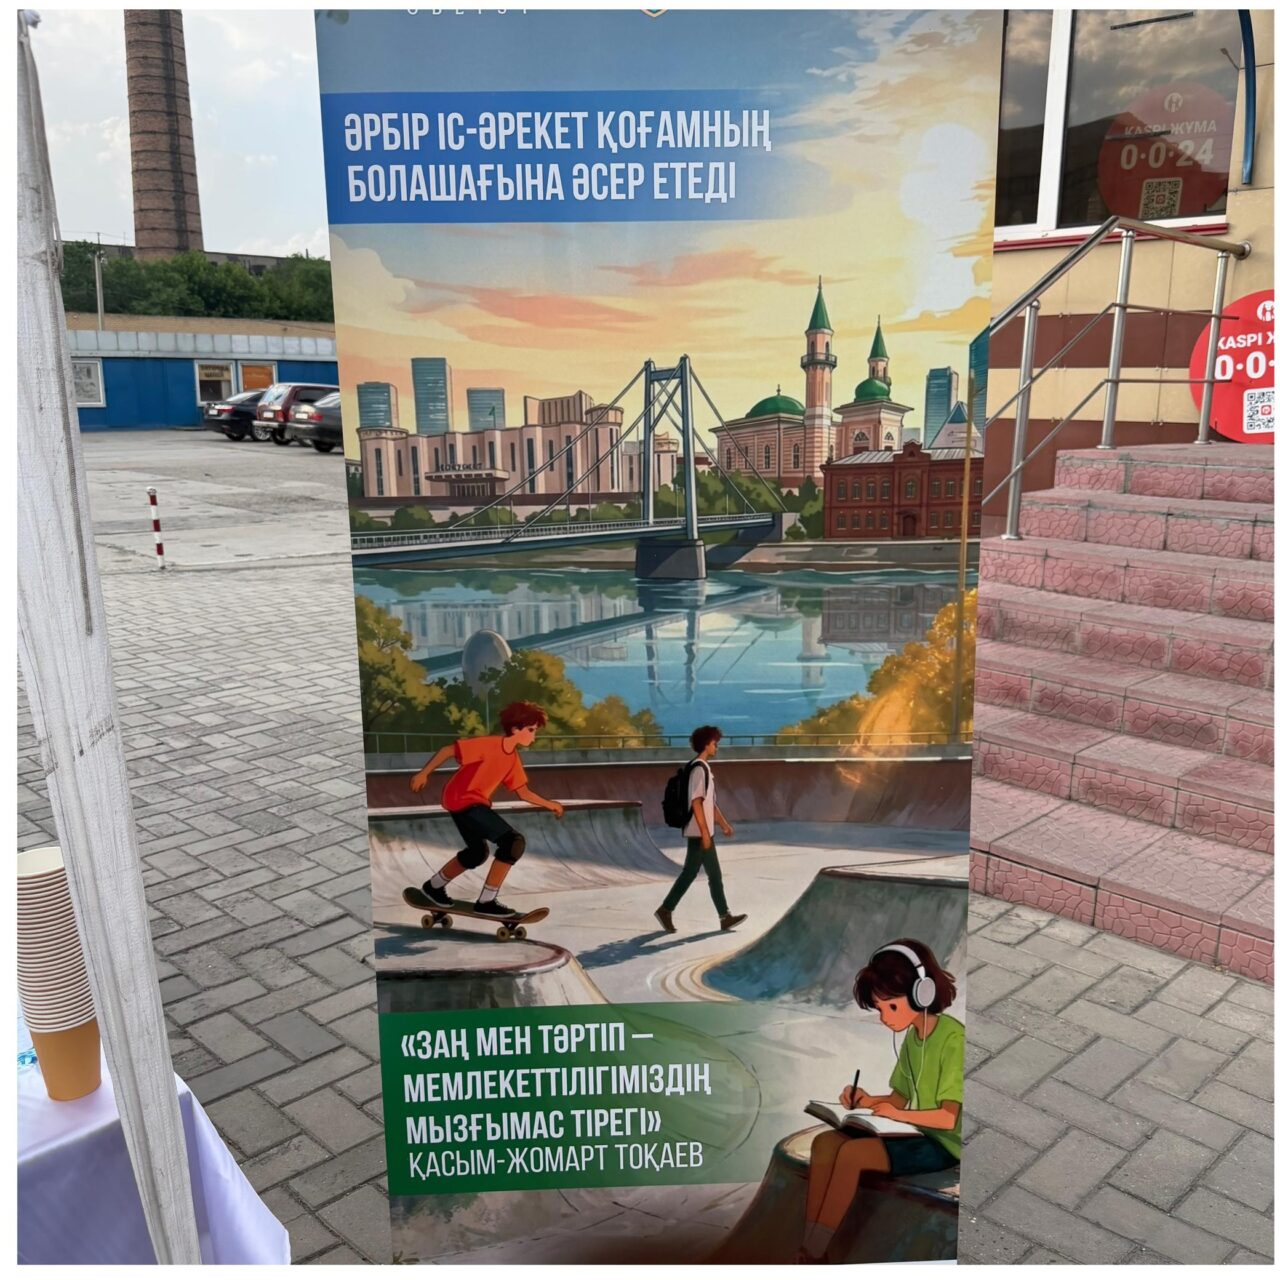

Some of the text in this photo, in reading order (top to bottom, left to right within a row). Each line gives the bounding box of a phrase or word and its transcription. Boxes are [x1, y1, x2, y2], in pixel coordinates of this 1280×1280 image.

[344, 109, 772, 153] ӘРБІР ІС-ӘРЕКЕТ ҚОҒАМНЫҢ
[347, 161, 737, 203] БОЛАШАҒЫНА ӘСЕР ЕТЕДІ
[1217, 332, 1263, 351] KASPI
[400, 1028, 469, 1061] «ЗАҢ
[476, 1025, 532, 1057] МЕН
[538, 1022, 626, 1054] ТӘРТІП
[403, 1063, 712, 1103] МЕМЛЕКЕТТІЛІГІМІЗДІҢ
[406, 1107, 662, 1145] МЫЗҒЫМАС ТІРЕГІ»
[409, 1141, 704, 1181] ҚАСЫМ-ЖОМАРТ ТОҚАЕВ
